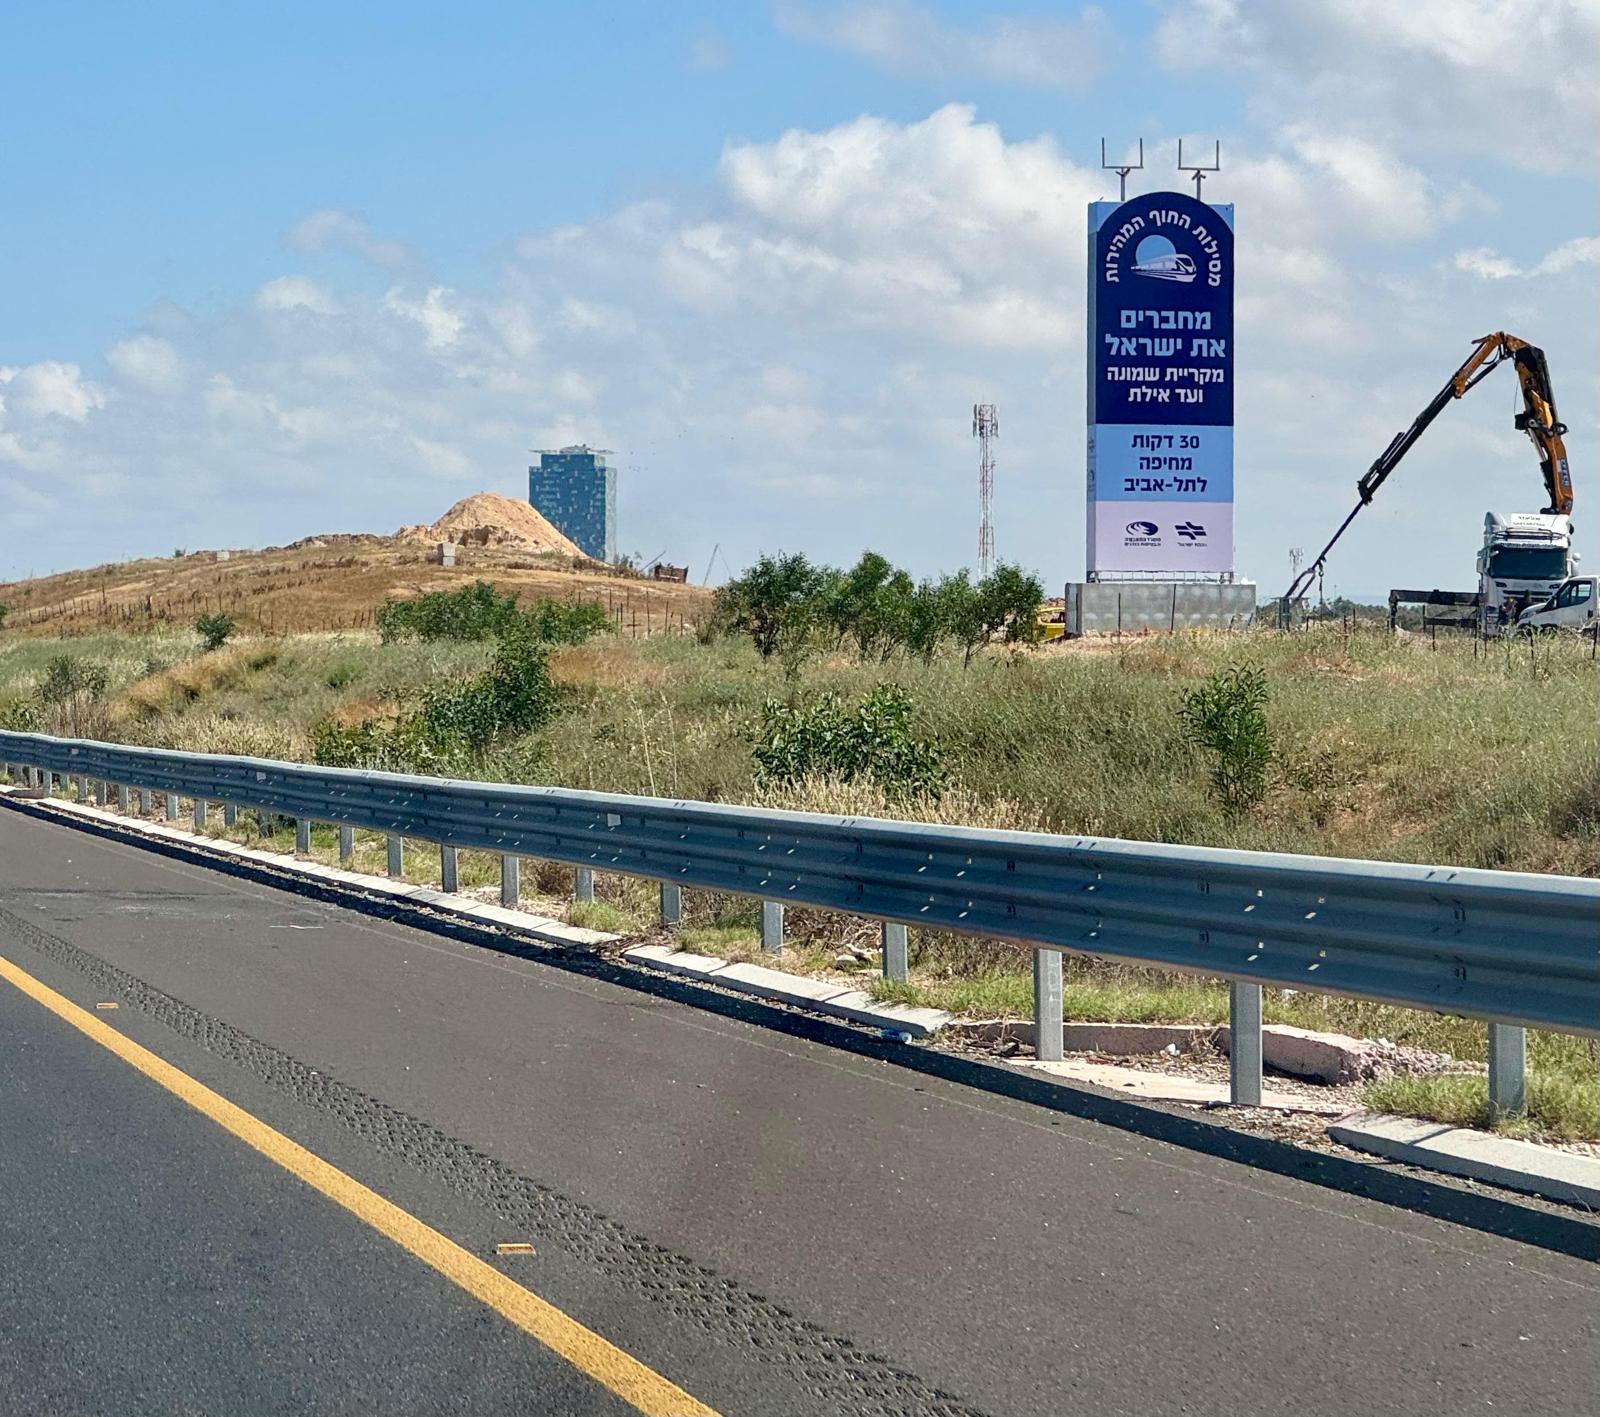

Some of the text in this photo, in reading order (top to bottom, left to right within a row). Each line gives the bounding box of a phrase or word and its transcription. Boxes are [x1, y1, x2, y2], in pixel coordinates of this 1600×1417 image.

[1105, 209, 1221, 287] מסילות החוף המהירות
[1120, 310, 1211, 330] מחברים
[1105, 333, 1226, 357] את ישראל
[1107, 366, 1224, 384] מקריית שמונה
[1128, 386, 1203, 402] ועד אילת
[1132, 434, 1199, 451] 30 דקות
[1139, 456, 1192, 470] מחיפה
[1124, 477, 1208, 492] לתל-אביב
